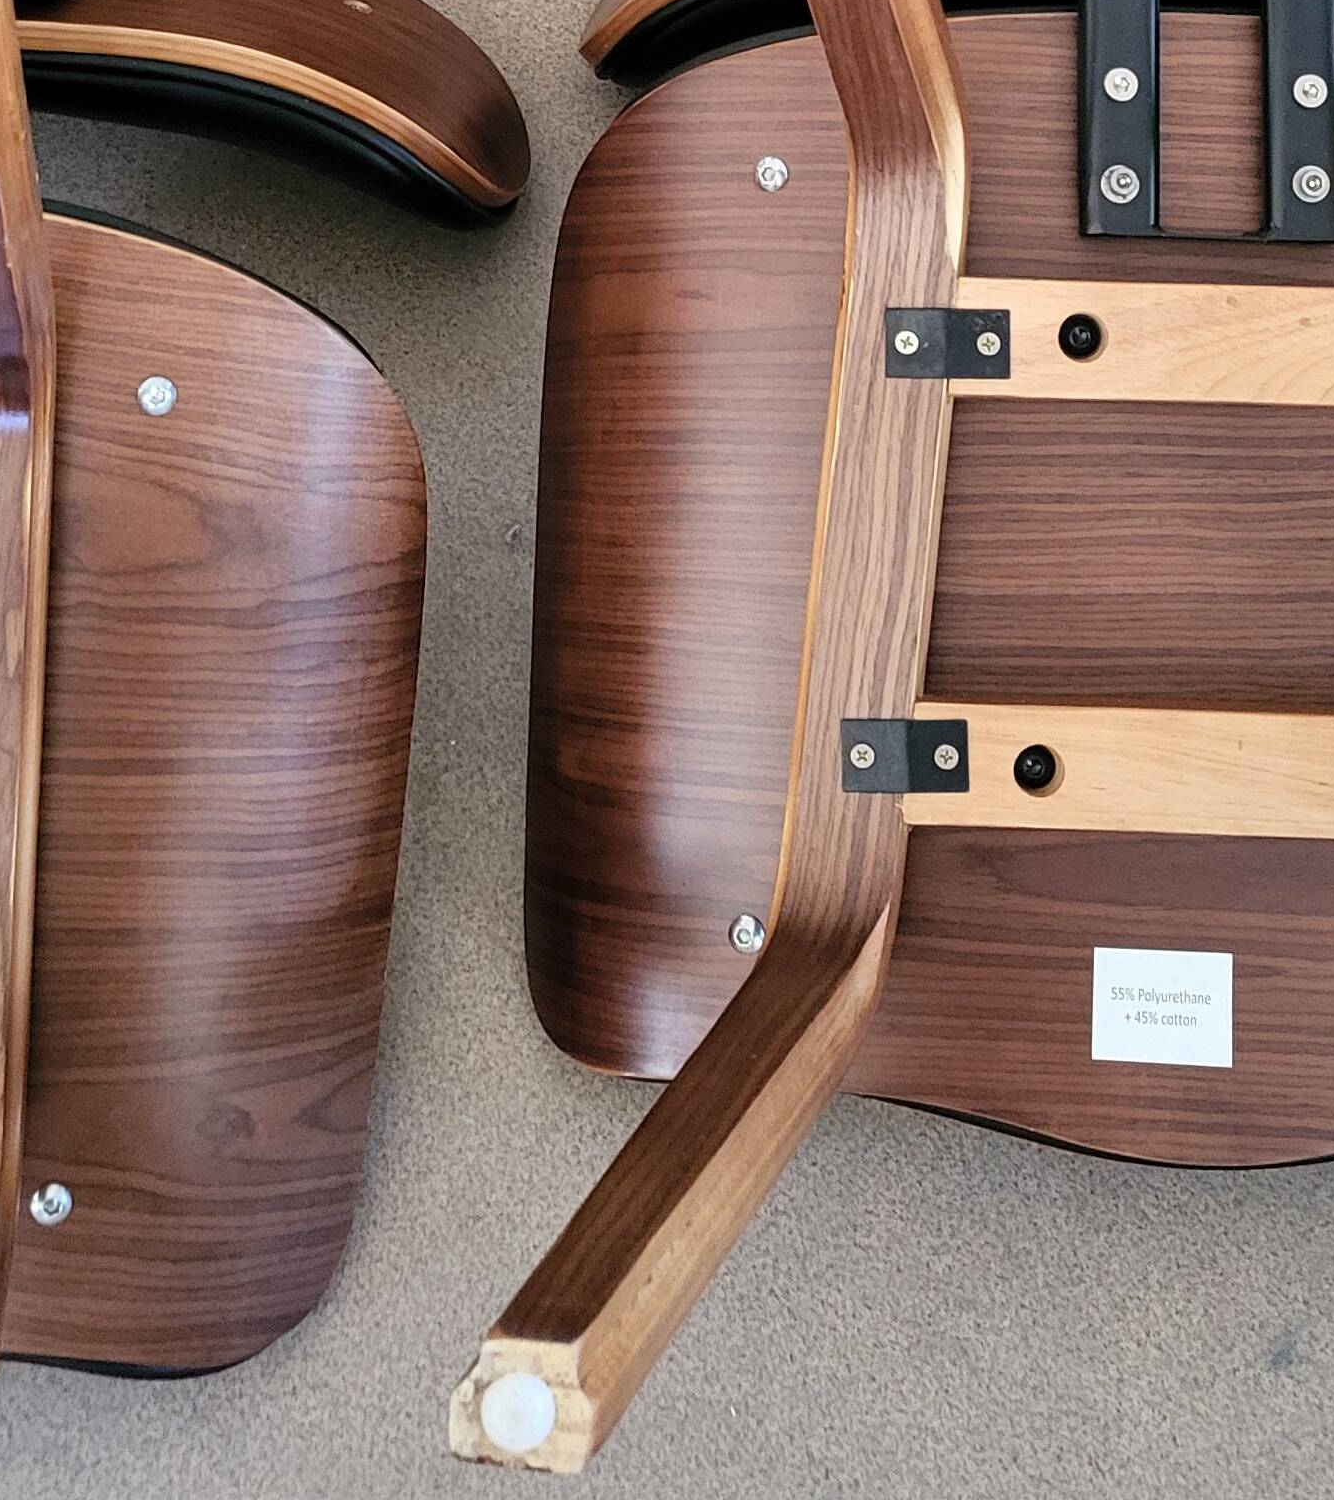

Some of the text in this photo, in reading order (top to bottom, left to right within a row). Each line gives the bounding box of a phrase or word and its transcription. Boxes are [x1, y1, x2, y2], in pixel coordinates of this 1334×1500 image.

[1111, 986, 1212, 1005] 55% Polyurethane
[1134, 1010, 1158, 1025] 45%
[1161, 1013, 1197, 1027] cotton
